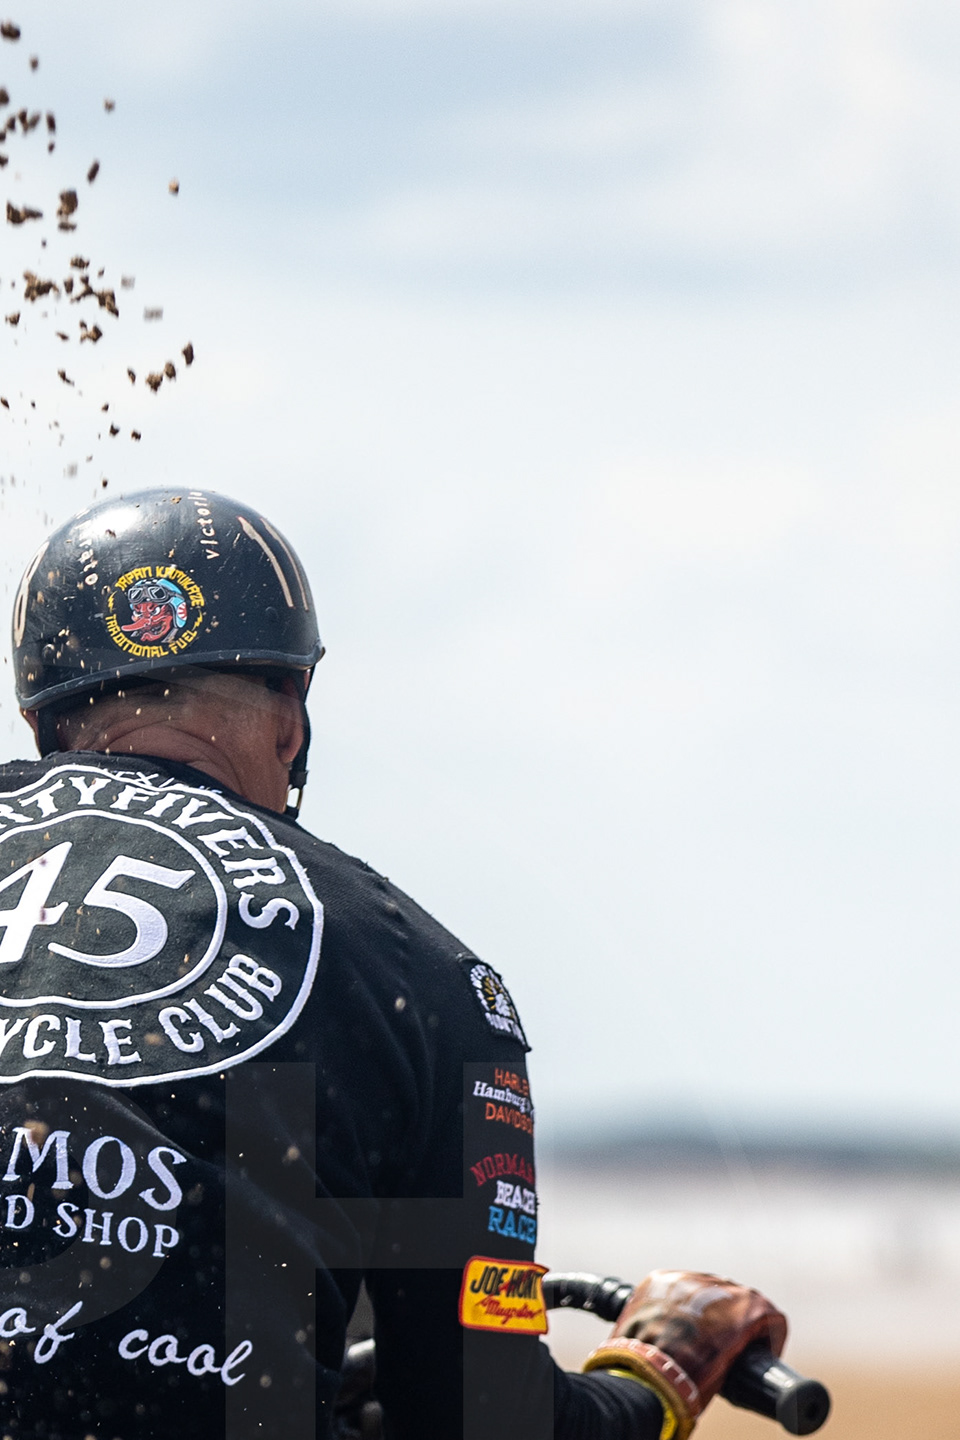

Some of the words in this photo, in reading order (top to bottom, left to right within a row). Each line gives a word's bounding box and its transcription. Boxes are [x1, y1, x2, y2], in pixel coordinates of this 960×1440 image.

[115, 566, 152, 591] JAPAN
[156, 565, 205, 606] KAMIKAZE
[105, 614, 169, 658] TRADITIONAL
[169, 630, 198, 654] FUEL
[158, 953, 283, 1053] CLUB
[52, 1202, 180, 1257] SHOP
[470, 1265, 508, 1296] JOE
[118, 1328, 253, 1386] cool
